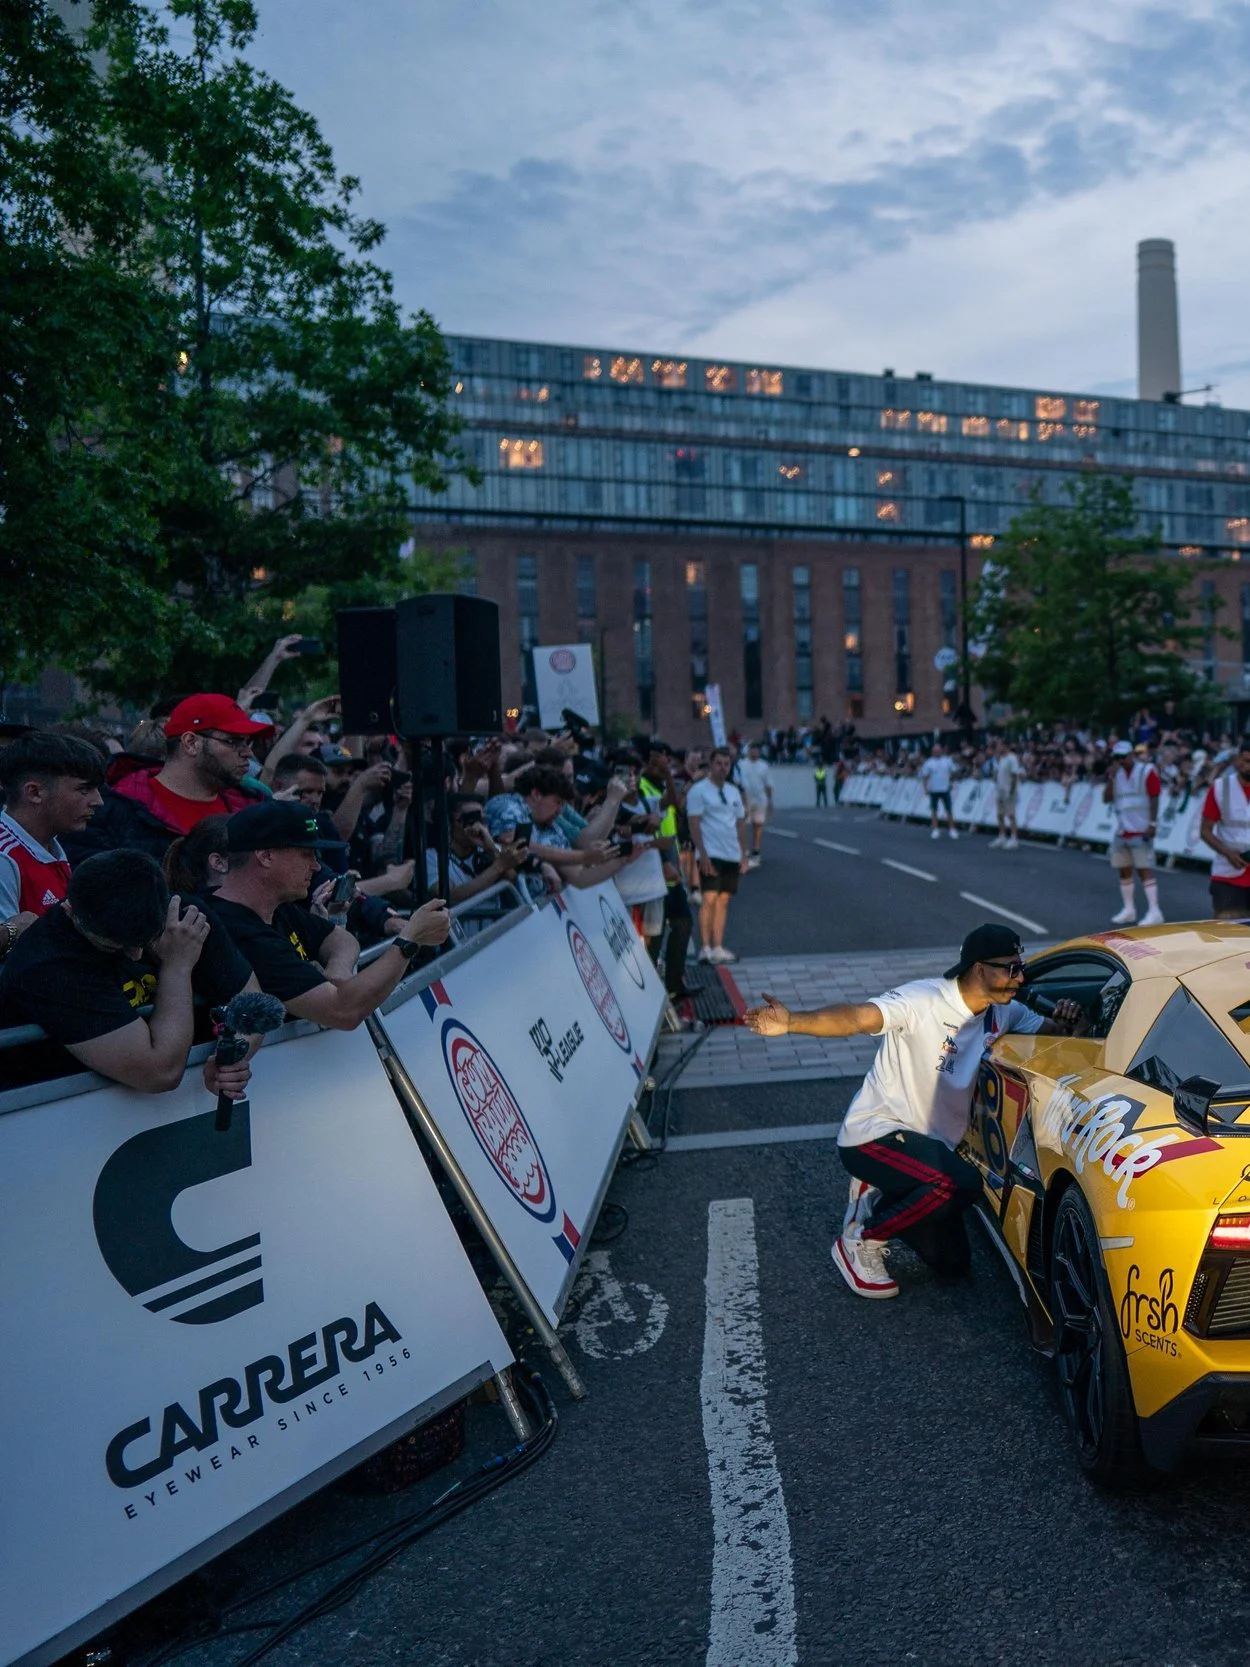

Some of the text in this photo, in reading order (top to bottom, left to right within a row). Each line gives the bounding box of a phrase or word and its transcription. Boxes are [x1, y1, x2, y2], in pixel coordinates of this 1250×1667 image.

[1072, 1099, 1180, 1209] Rock
[1120, 1264, 1179, 1339] frsh
[1135, 1328, 1178, 1358] SCENTS
[105, 1301, 403, 1489] CARRERA
[124, 1347, 412, 1521] EYEWEAR SINCE 1956
